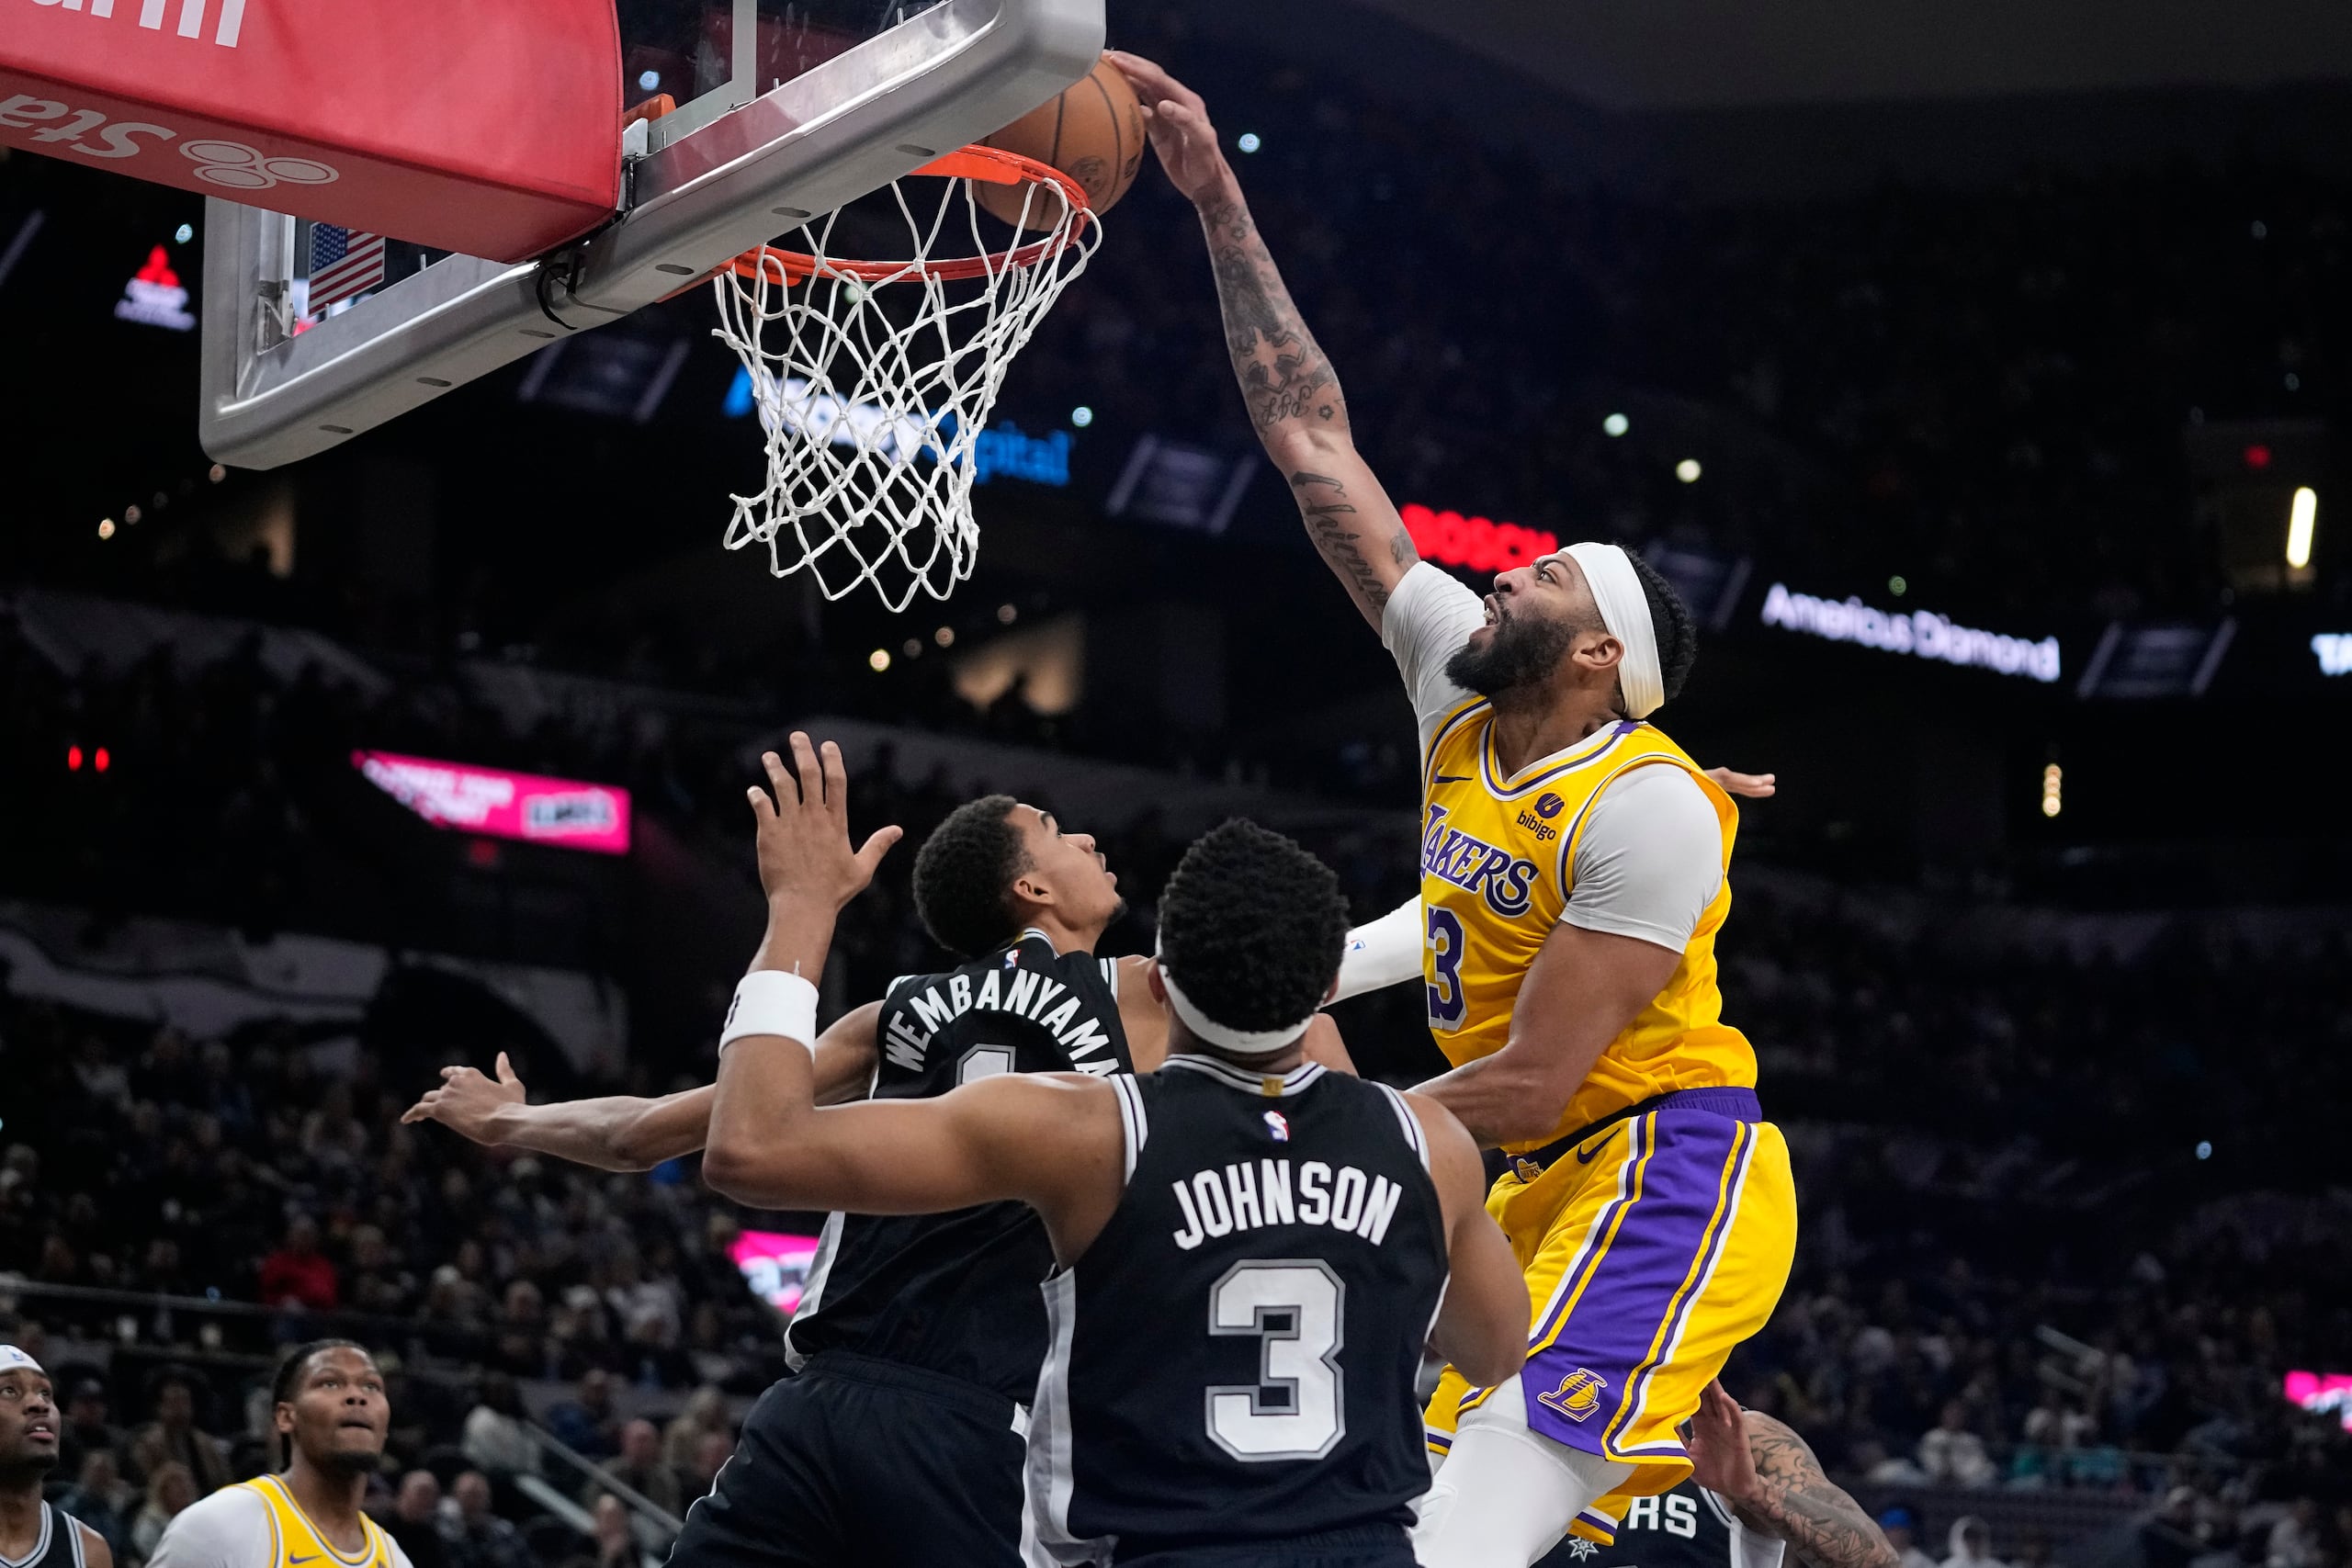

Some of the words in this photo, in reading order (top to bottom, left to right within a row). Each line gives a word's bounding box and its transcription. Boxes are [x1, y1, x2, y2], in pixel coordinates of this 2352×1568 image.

[1420, 802, 1540, 918] LAKERS
[1516, 810, 1556, 841] bibigo
[1426, 903, 1467, 1032] 3
[1171, 1158, 1403, 1251] JOHNSON
[1204, 1258, 1347, 1463] 3
